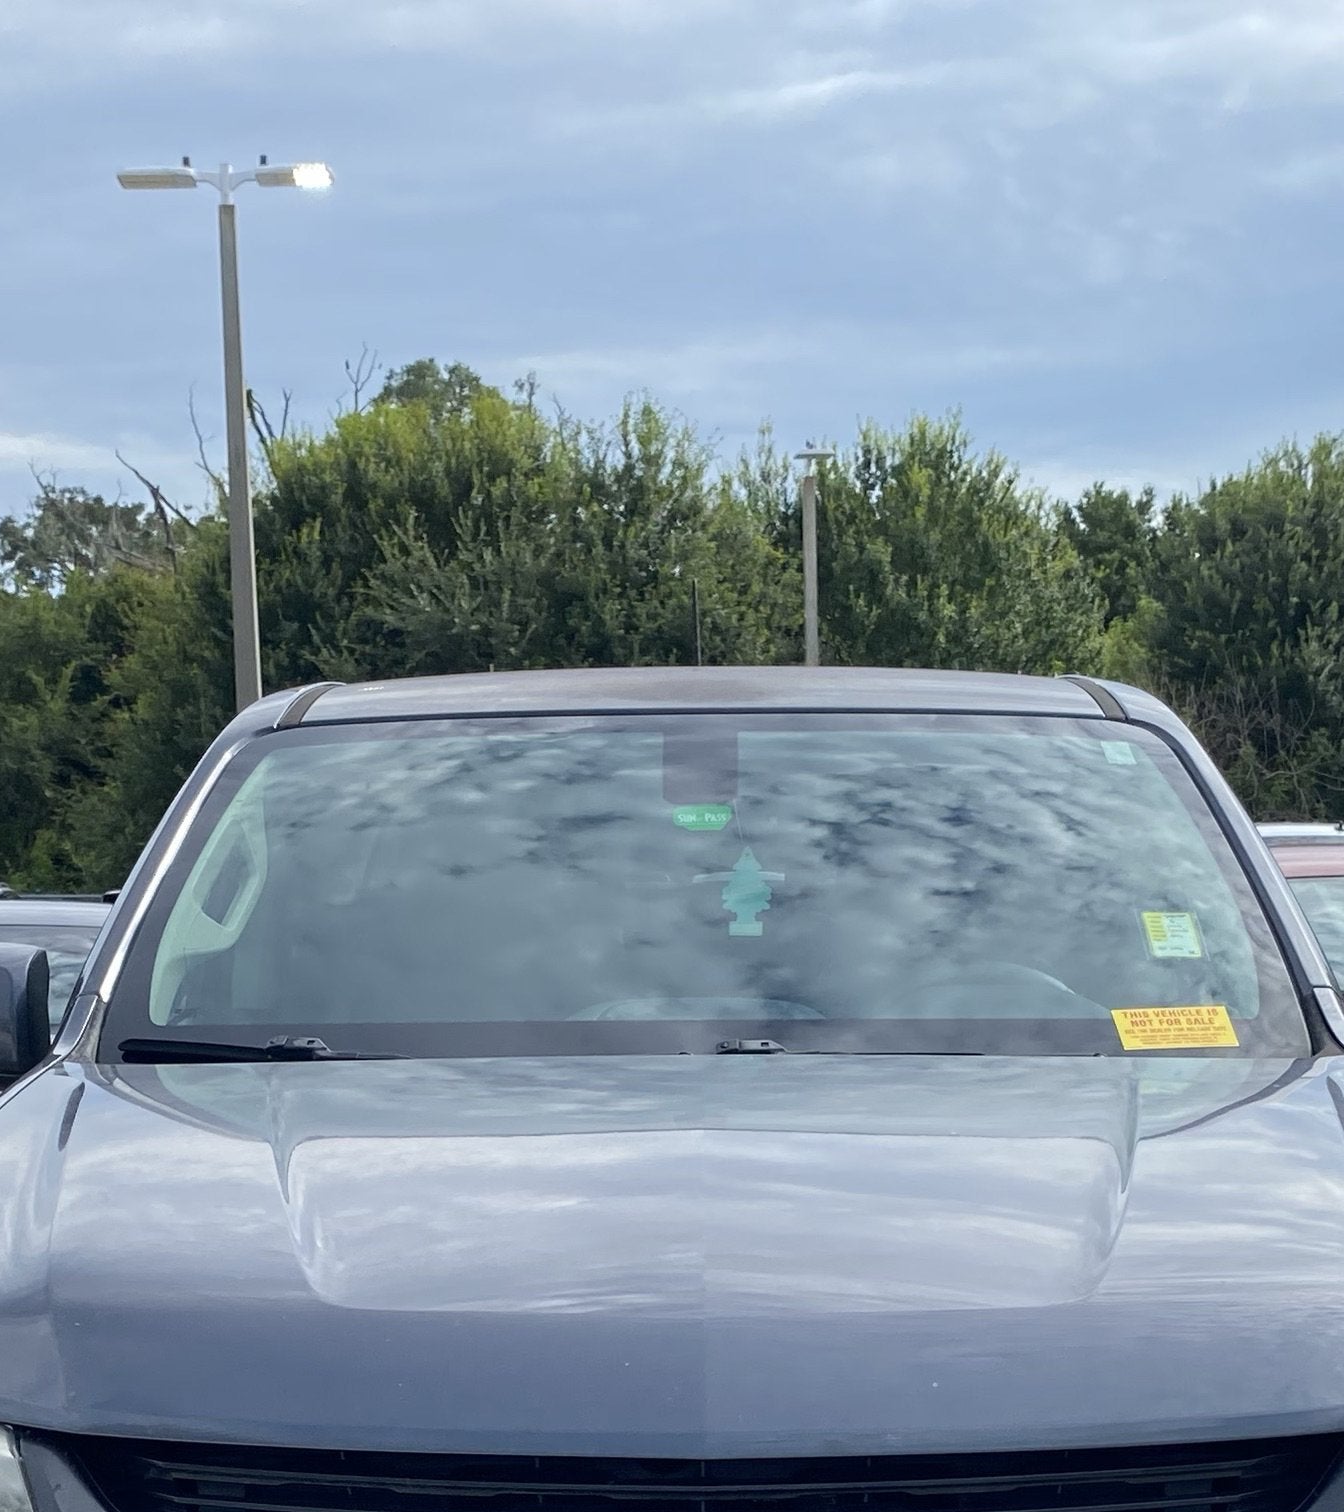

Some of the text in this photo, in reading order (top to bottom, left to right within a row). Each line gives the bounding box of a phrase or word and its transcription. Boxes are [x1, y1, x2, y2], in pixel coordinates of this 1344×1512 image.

[677, 812, 726, 823] SUN PASS
[1121, 1008, 1219, 1019] THIS VEHICLE IS
[1130, 1017, 1216, 1027] NOT FOR SALE
